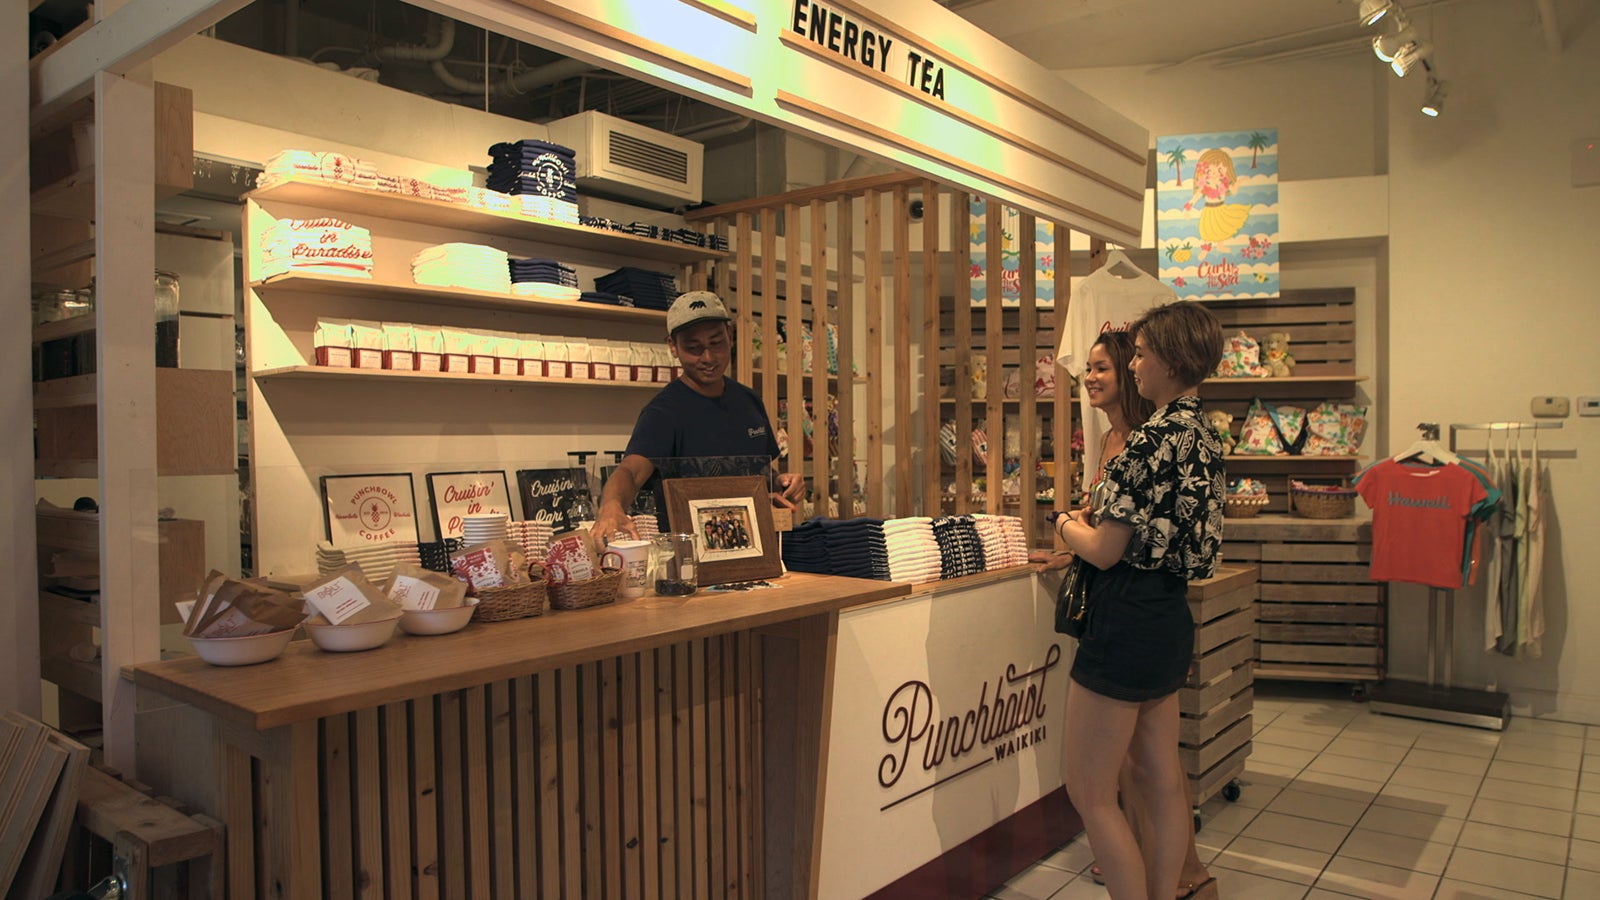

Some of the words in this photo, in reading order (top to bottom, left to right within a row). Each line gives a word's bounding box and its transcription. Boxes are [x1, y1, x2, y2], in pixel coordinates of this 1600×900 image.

[793, 0, 893, 72] ENERGY
[908, 51, 945, 101] TEA
[351, 486, 398, 504] PUNCHBOWL
[444, 481, 495, 504] Cruisin'
[467, 499, 481, 515] in
[359, 528, 395, 541] COFFEE
[878, 644, 1061, 788] Punchbowl
[995, 725, 1047, 761] WAIKIKI
